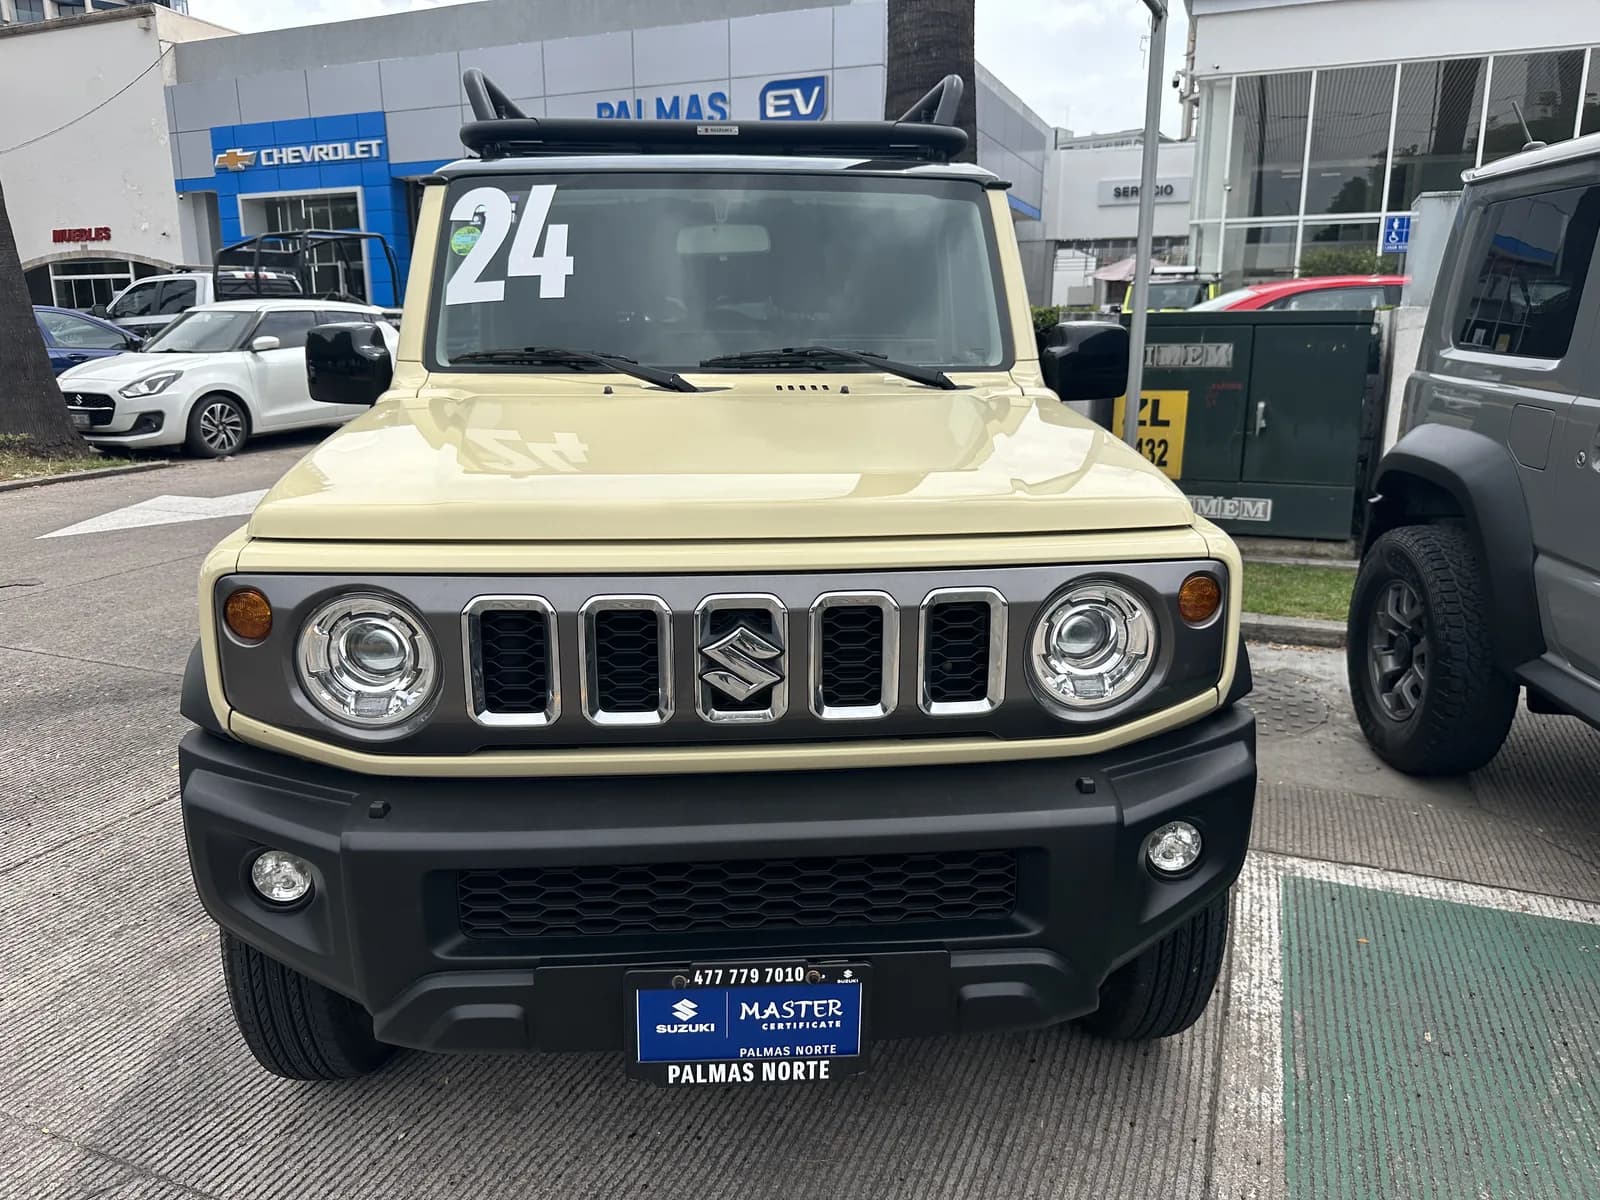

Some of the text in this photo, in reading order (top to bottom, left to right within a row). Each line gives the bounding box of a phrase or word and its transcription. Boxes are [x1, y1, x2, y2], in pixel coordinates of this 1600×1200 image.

[597, 92, 730, 120] PALMAS
[766, 86, 821, 119] EV
[260, 139, 384, 166] CHEVROLET
[1113, 184, 1174, 198] SERCIO
[445, 184, 574, 306] 24
[1190, 498, 1267, 519] MEM
[694, 966, 804, 985] 477 779 7010
[739, 999, 843, 1020] MASTER
[655, 1023, 715, 1034] SUZUKI
[762, 1020, 841, 1031] CERTIFICATE
[739, 1044, 837, 1058] PALMAS NORTE
[667, 1060, 830, 1084] PALMAS NORTE
